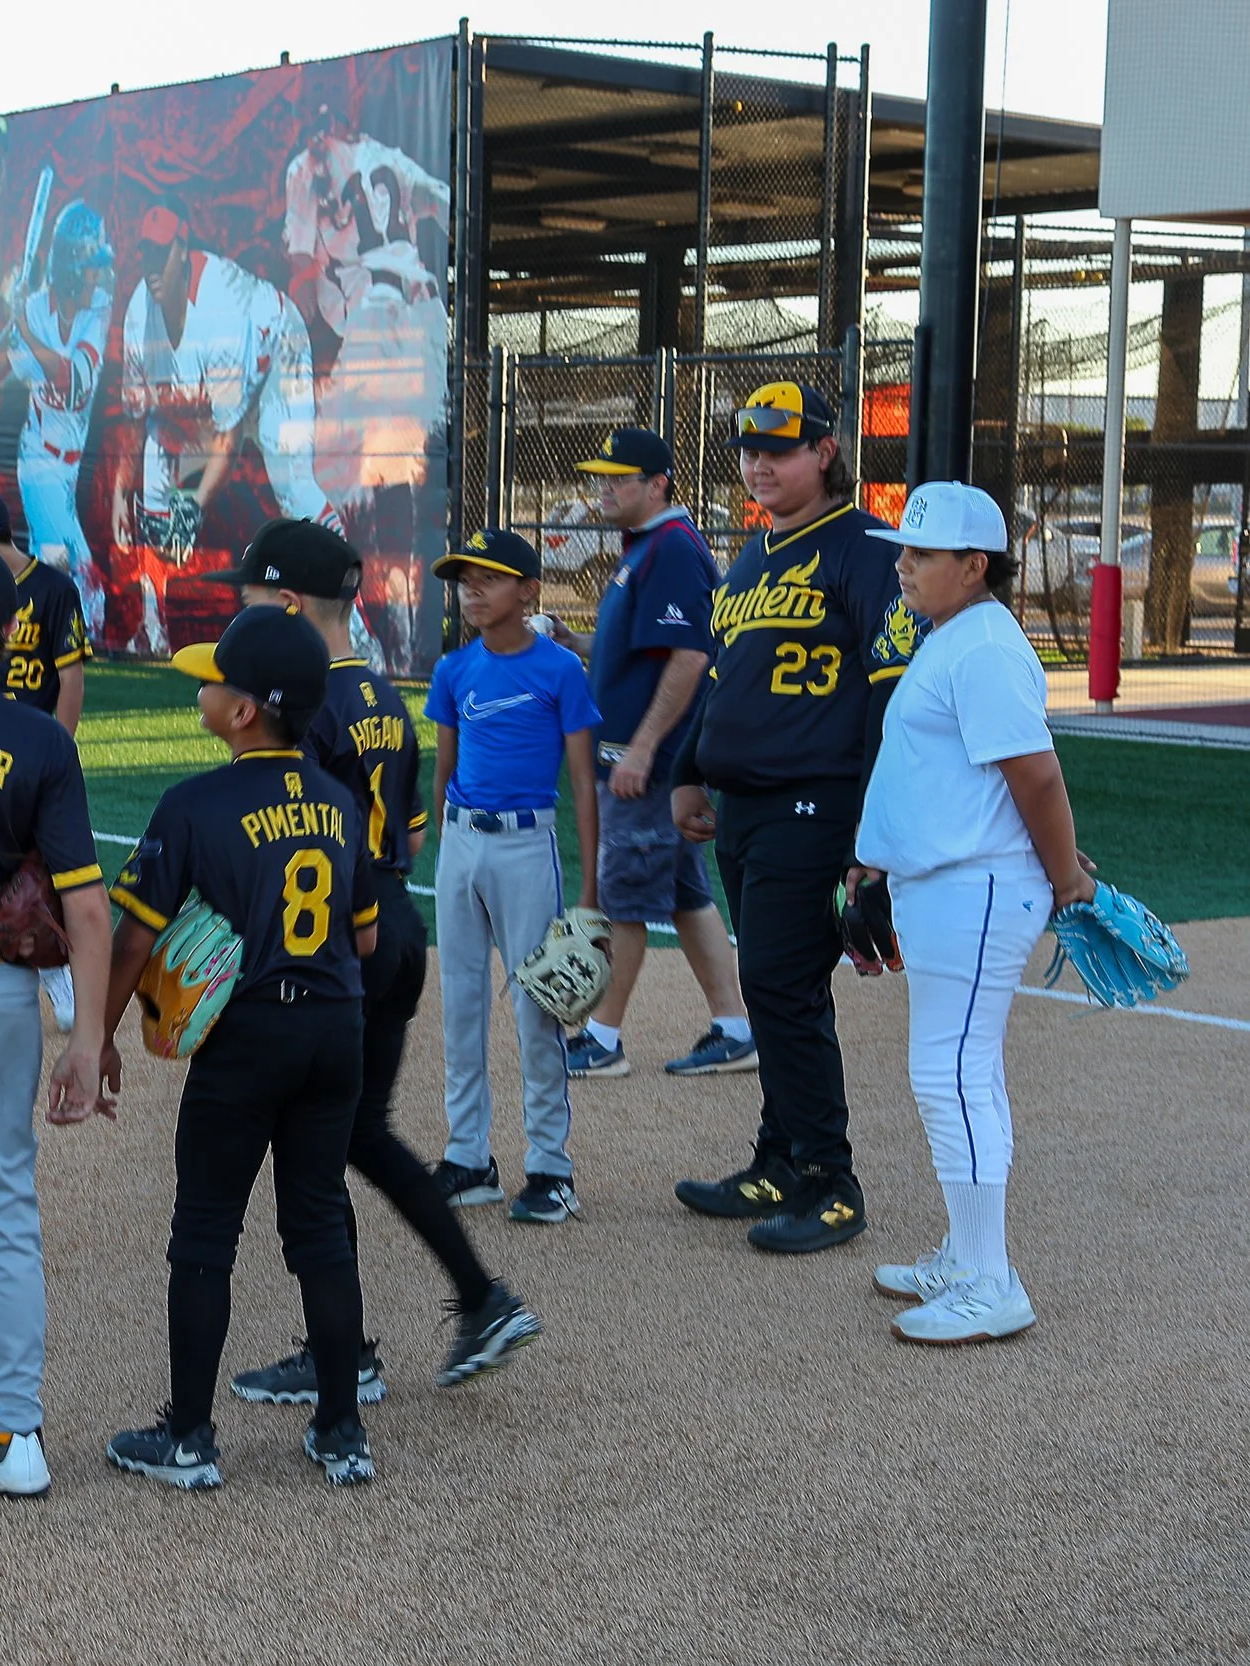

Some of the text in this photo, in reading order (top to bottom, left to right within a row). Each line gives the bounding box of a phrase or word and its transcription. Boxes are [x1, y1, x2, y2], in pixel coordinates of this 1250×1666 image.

[6, 655, 45, 691] 20
[770, 641, 842, 696] 23
[240, 802, 346, 849] PIMENTAL
[282, 848, 333, 957] 8
